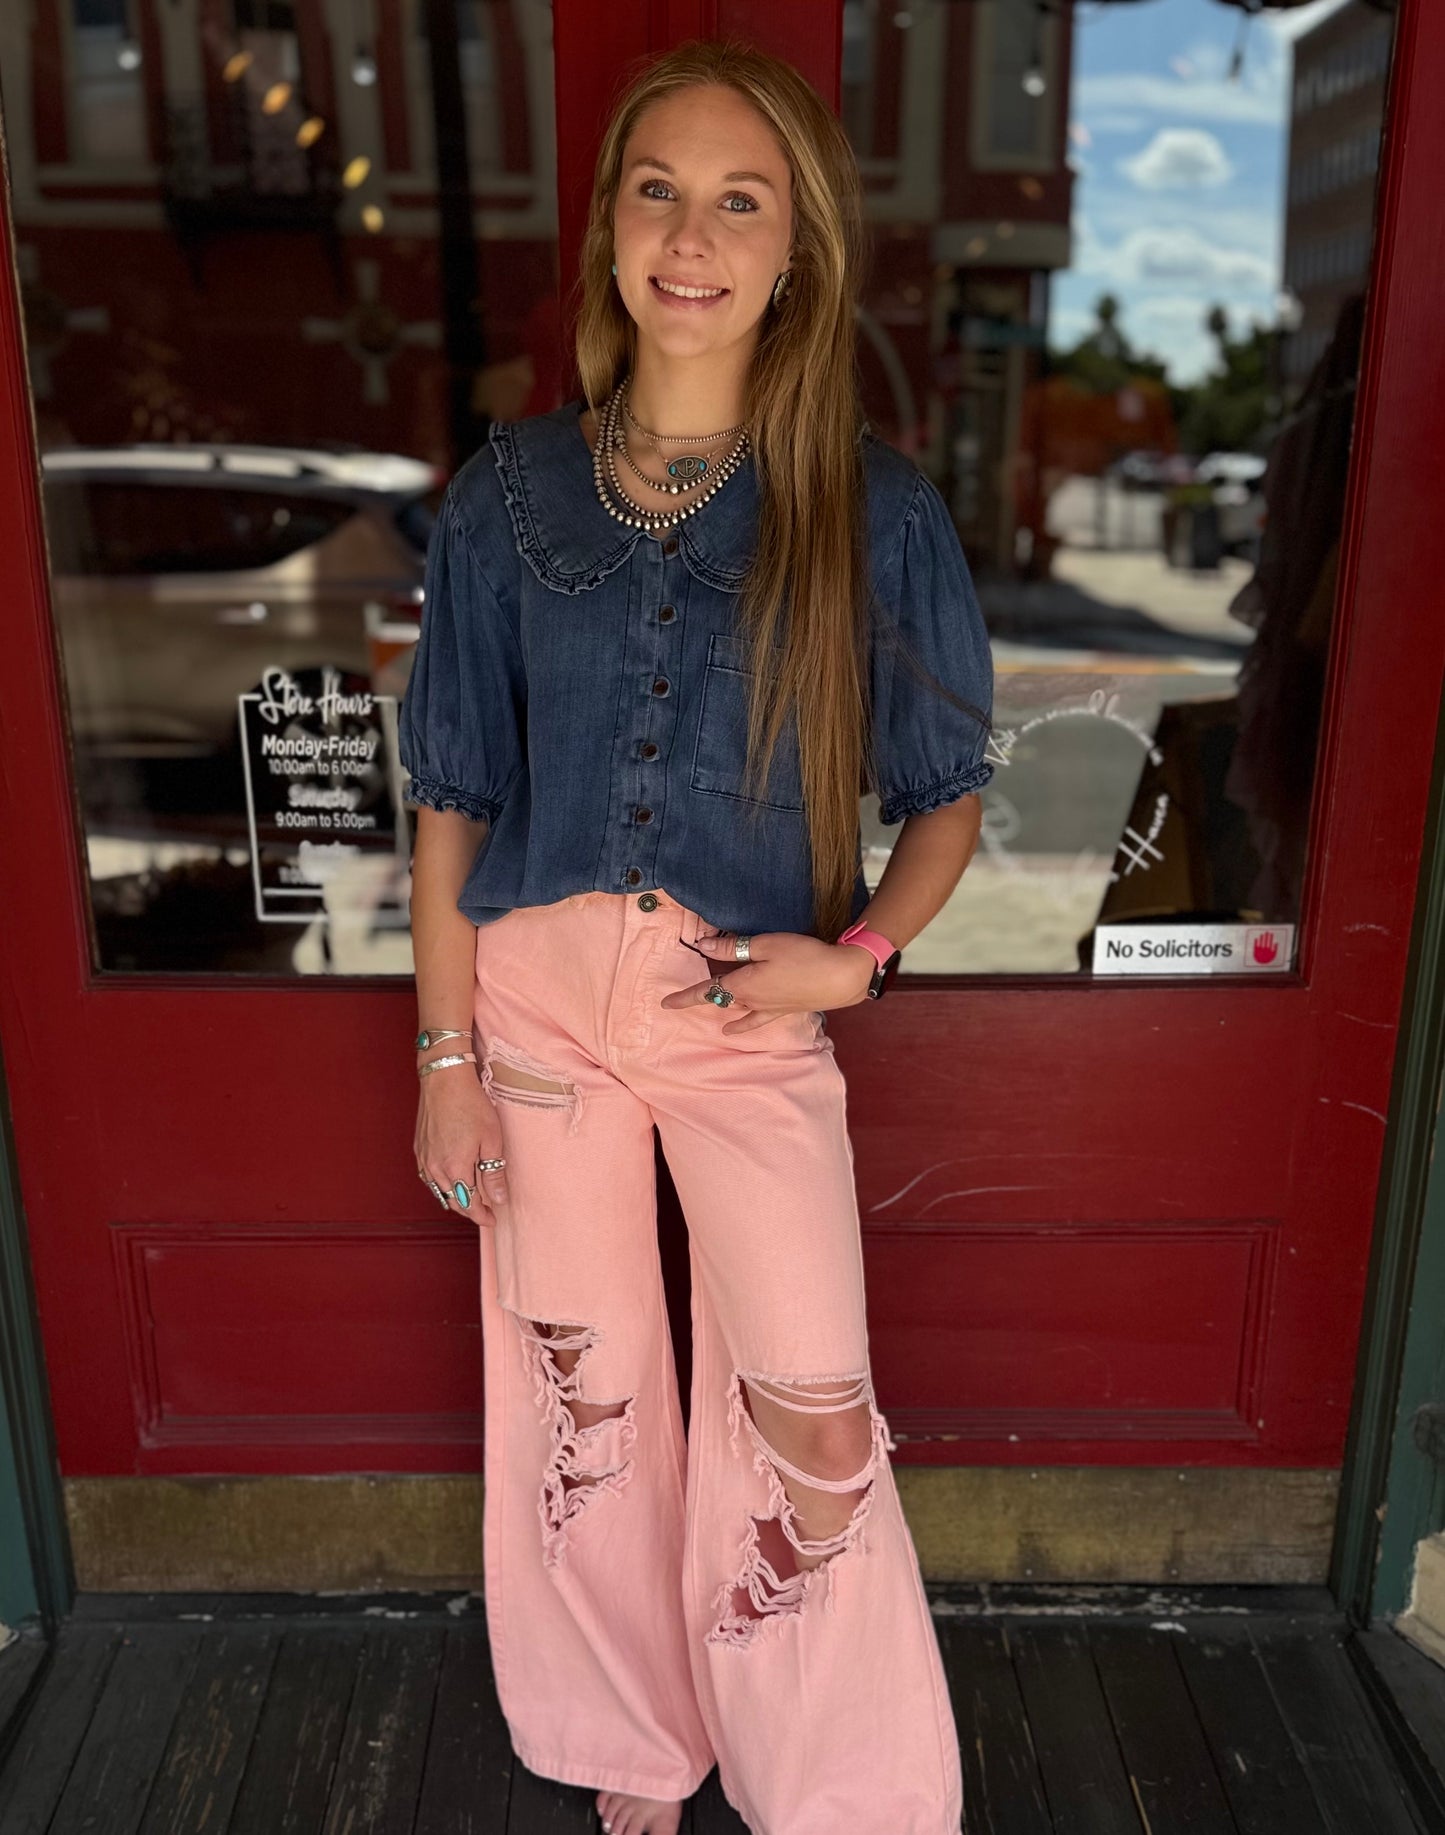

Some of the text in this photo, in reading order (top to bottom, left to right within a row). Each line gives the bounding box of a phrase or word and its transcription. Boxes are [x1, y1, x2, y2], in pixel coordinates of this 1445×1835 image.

[258, 665, 373, 725] Store Hours
[261, 734, 377, 761] Monday-Friday
[317, 760, 330, 775] to
[319, 812, 332, 828] to
[1106, 939, 1233, 959] No Solicitors
